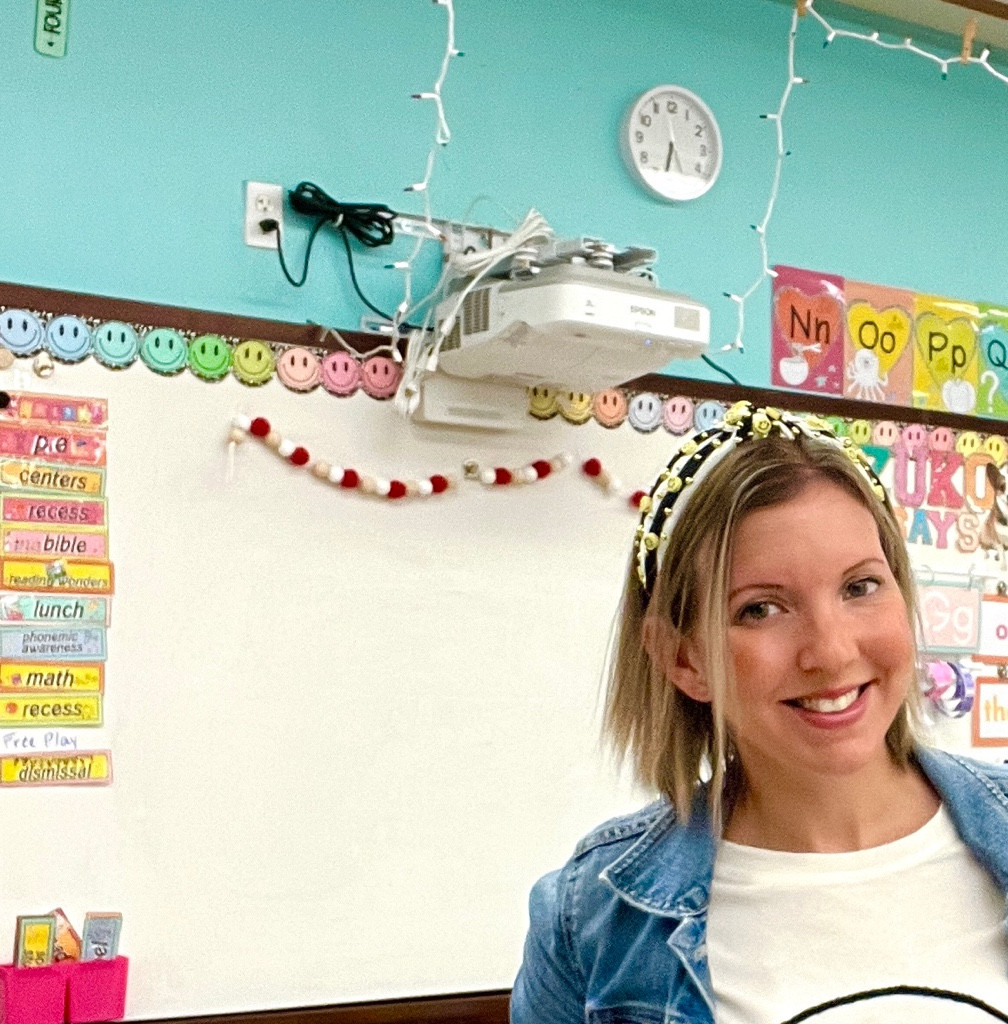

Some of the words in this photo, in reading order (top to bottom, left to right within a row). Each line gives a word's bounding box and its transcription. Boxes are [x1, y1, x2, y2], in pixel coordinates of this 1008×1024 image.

[695, 124, 703, 137] 2
[790, 304, 831, 345] Nn
[858, 320, 896, 354] Oo
[928, 331, 967, 376] Pp
[19, 468, 88, 490] centers
[28, 503, 90, 521] recess
[44, 534, 87, 553] bible
[33, 600, 85, 619] lunch
[22, 631, 78, 644] phonemic
[21, 643, 83, 654] awareness
[25, 669, 75, 687] math
[22, 703, 83, 718] recess
[3, 732, 36, 749] Free
[44, 732, 78, 750] Play
[18, 761, 92, 782] dismissal
